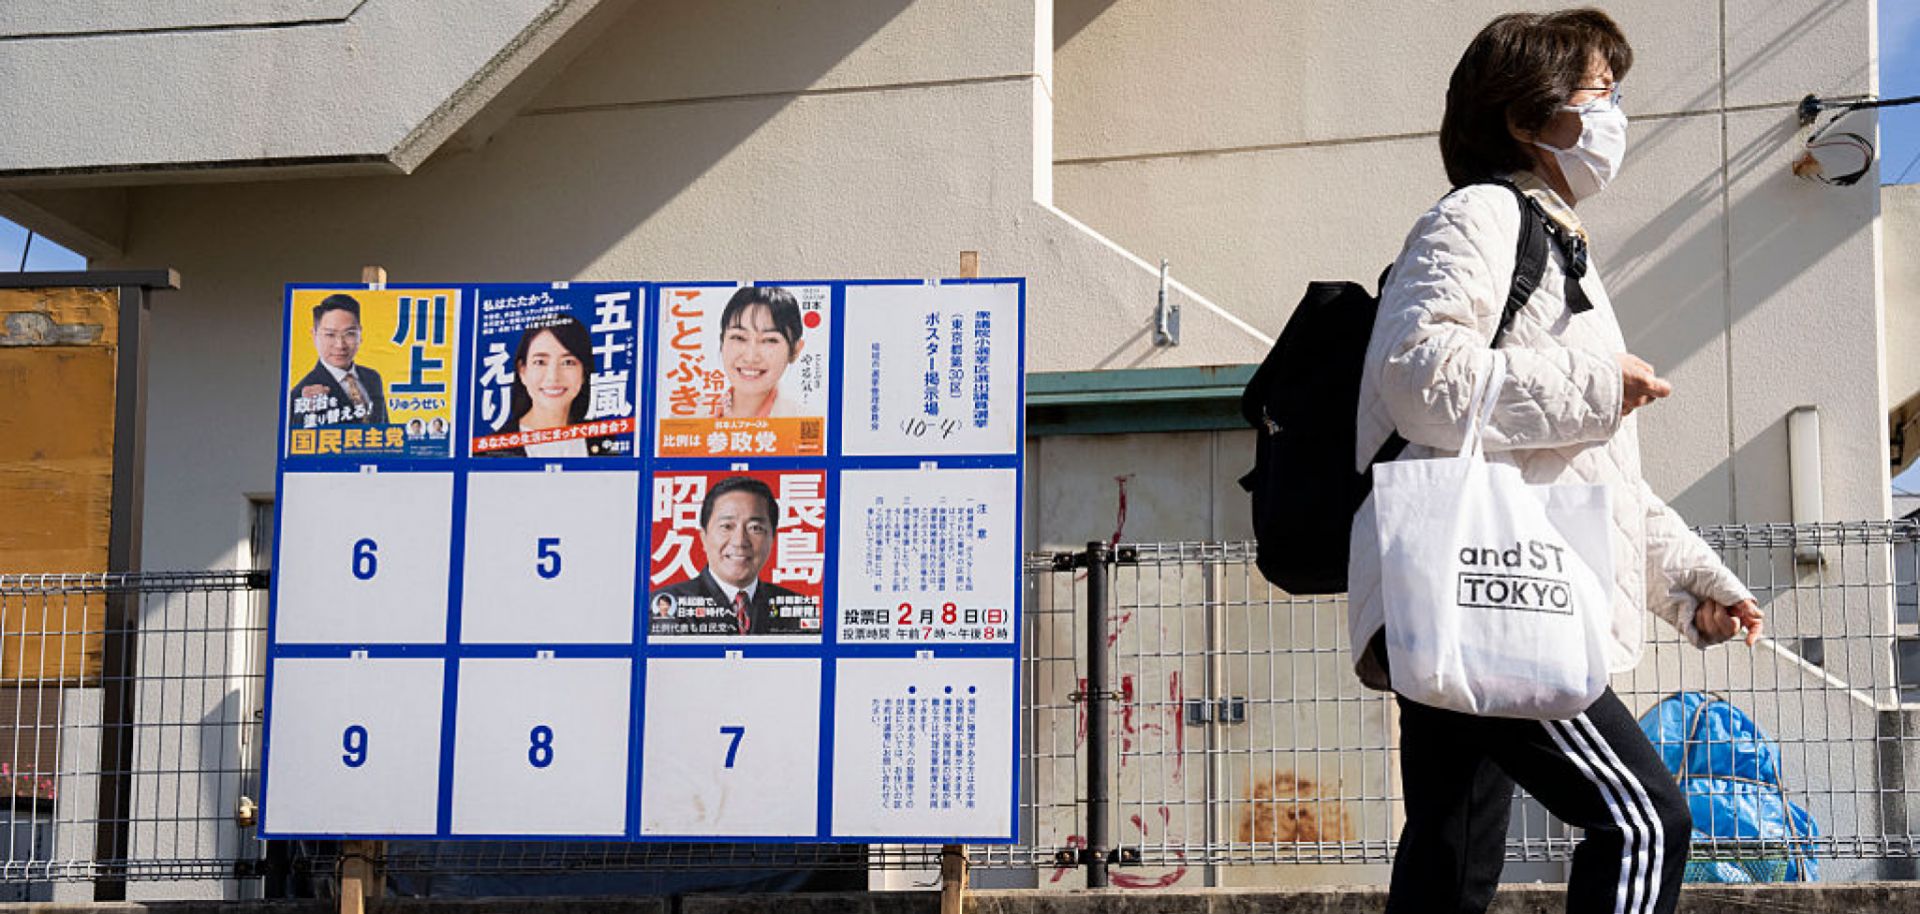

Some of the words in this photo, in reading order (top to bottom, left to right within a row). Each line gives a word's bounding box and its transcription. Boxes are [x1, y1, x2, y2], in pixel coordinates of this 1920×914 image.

[482, 291, 554, 312] 私はたたかう。
[802, 301, 822, 310] 日本
[391, 296, 446, 392] 川上
[585, 292, 632, 420] 五十嵐
[667, 290, 705, 416] ことぶき
[924, 312, 940, 416] ポスター掲示場
[293, 394, 338, 414] 政治を
[480, 342, 515, 432] えり
[701, 369, 725, 415] 玲子
[290, 427, 404, 455] 国民民主党
[663, 434, 701, 448] 比例は
[706, 431, 777, 453] 参政党
[651, 476, 708, 586] 昭久
[772, 474, 826, 584] 長島
[350, 537, 379, 582] 6
[535, 537, 562, 581] 5
[1459, 541, 1521, 568] and
[1529, 539, 1564, 573] ST
[1464, 578, 1569, 608] TOKYO
[843, 627, 890, 640] 投票時間
[844, 609, 890, 625] 投票日
[341, 724, 369, 769] 9
[527, 723, 555, 770] 8
[719, 725, 746, 770] 7
